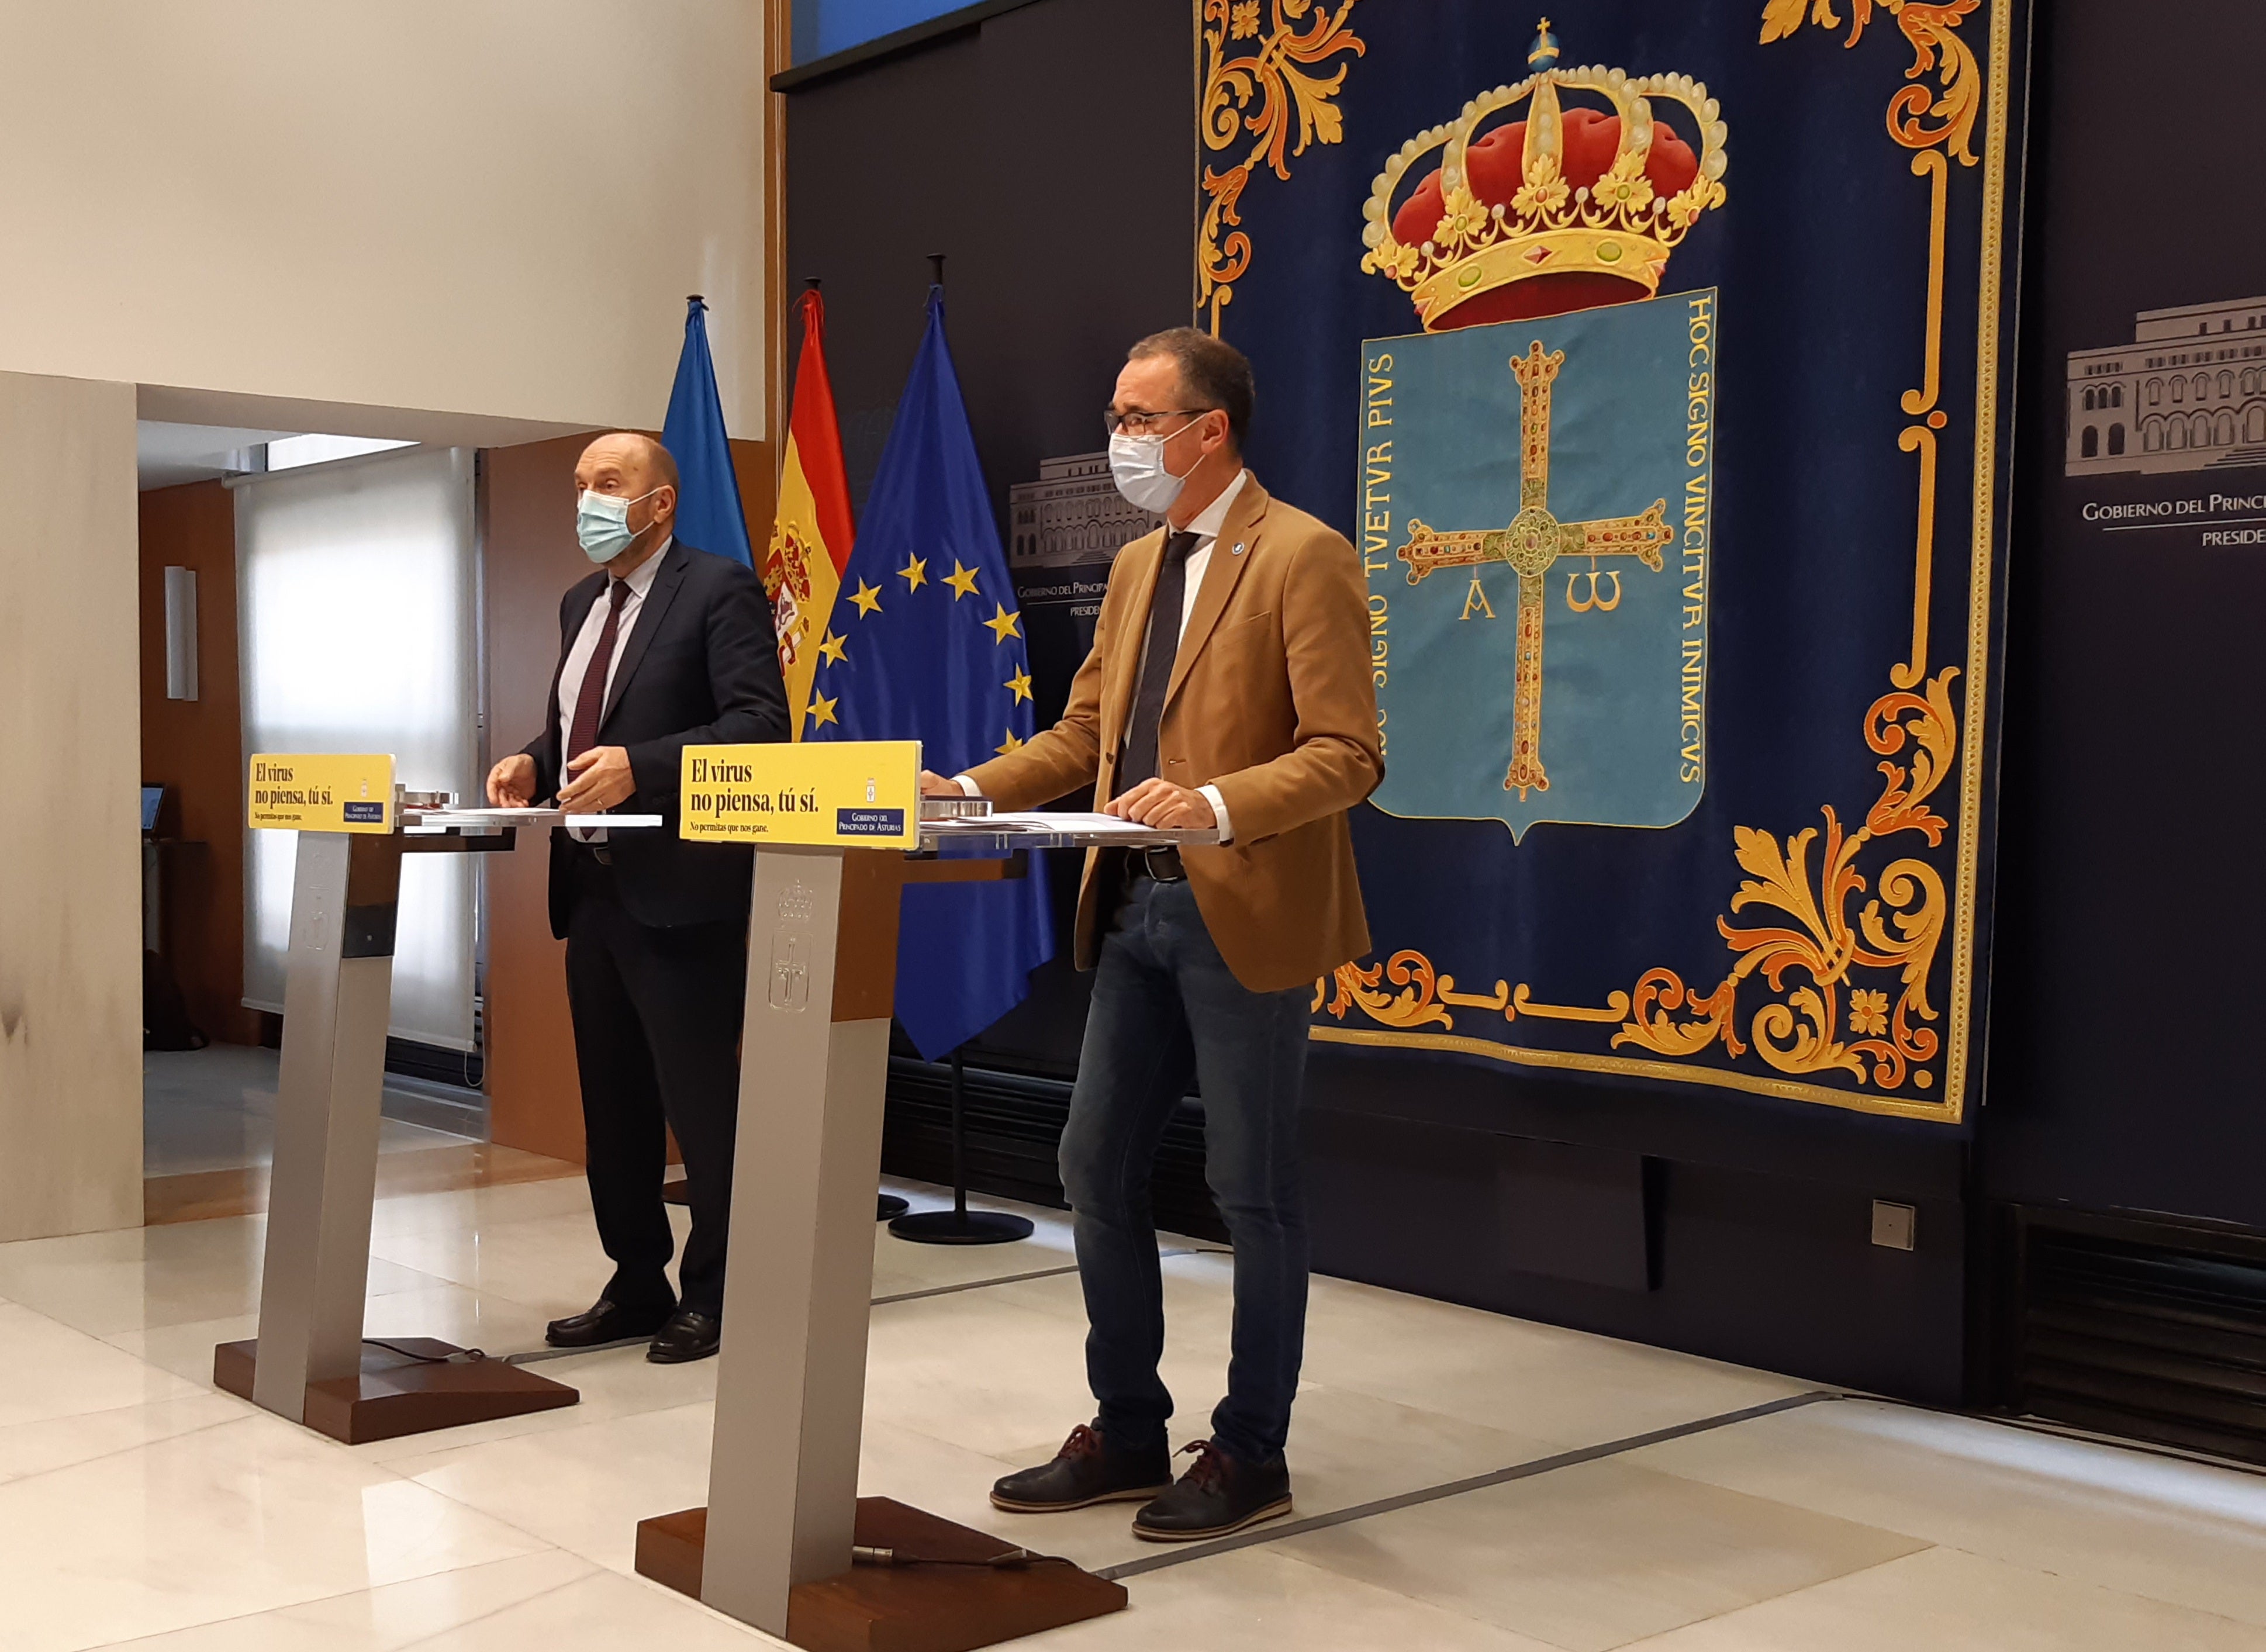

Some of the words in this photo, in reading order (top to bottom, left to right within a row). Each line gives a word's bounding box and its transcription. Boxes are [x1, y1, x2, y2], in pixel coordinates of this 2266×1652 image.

[1689, 295, 1711, 368] HOC
[1368, 353, 1393, 429] PIVS
[1687, 372, 1710, 467] SIGNO
[1364, 440, 1393, 578] TVETVR
[2082, 502, 2172, 520] GOBIERNO
[2176, 500, 2205, 514] DEL
[2202, 528, 2266, 546] PRESIDE
[1683, 474, 1707, 630] VINCITVR
[1058, 586, 1072, 595] DEL
[1070, 606, 1101, 616] PRESIDE
[1680, 638, 1702, 783] INIMICVS
[256, 763, 265, 782] El
[268, 763, 293, 782] virus
[692, 759, 706, 782] El
[711, 759, 752, 783] virus
[255, 790, 268, 804] no
[270, 786, 306, 809] piensa,
[309, 786, 319, 804] tú
[322, 786, 333, 805] sí.
[691, 793, 711, 811] no
[716, 788, 774, 818] piensa,
[779, 788, 795, 813] tú
[800, 787, 818, 813] sí.
